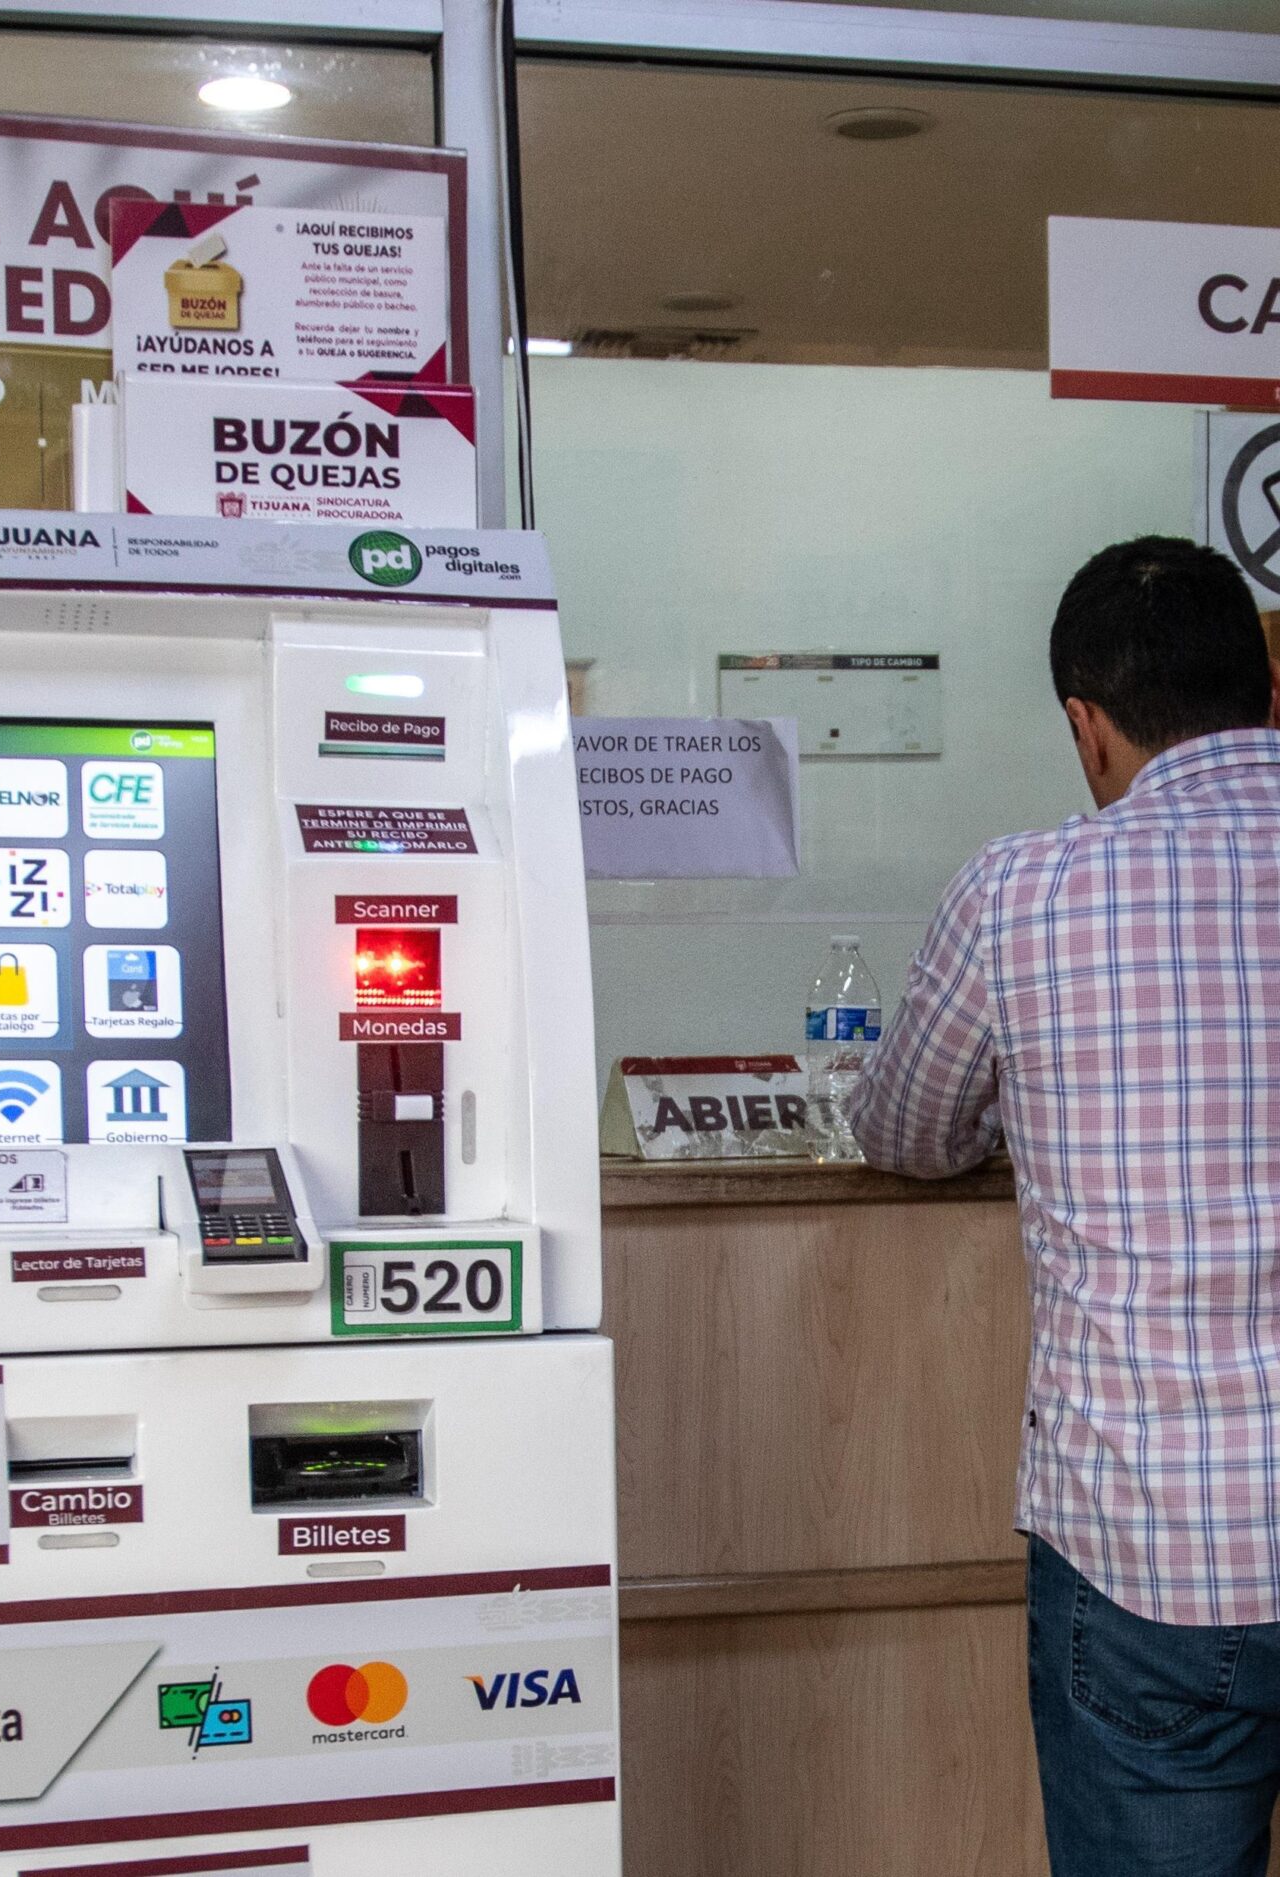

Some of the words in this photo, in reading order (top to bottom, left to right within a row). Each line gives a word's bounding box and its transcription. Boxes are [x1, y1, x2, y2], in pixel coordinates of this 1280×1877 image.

[297, 221, 335, 237] ¡AQUÍ
[339, 225, 414, 240] RECIBIMOS
[313, 243, 339, 255] TUS
[343, 244, 402, 258] QUEJAS!
[302, 262, 321, 271] Ante
[355, 264, 365, 272] de
[381, 266, 414, 275] servicio
[384, 279, 408, 287] como
[181, 297, 226, 310] BUZÓN
[1198, 273, 1280, 334] CA
[193, 311, 225, 320] QUEJAS
[377, 326, 410, 335] nombre
[136, 332, 254, 357] ¡AYÚDANOS
[260, 340, 275, 357] A
[317, 347, 347, 357] QUEJA
[357, 349, 417, 360] SUGERENCIA.
[213, 411, 400, 458] BUZÓN
[215, 461, 260, 485] DE
[271, 462, 401, 491] QUEJAS
[251, 501, 311, 511] TIJUANA
[317, 498, 390, 508] SINDICATURA
[317, 509, 403, 520] PROCURADORA
[128, 538, 219, 548] RESPONSABILIDAD
[425, 543, 480, 557] pagos
[144, 547, 180, 556] TODOS
[361, 544, 413, 575] pd
[445, 558, 521, 575] digitales
[499, 573, 522, 581] .com
[851, 658, 871, 666] TIPO
[874, 658, 885, 666] DE
[887, 658, 923, 666] CAMBIO
[330, 718, 378, 733] Recibo
[381, 722, 400, 734] de
[404, 723, 441, 737] Pago
[574, 736, 629, 751] AVOR
[634, 736, 658, 751] DE
[664, 736, 722, 752] TRAER
[729, 736, 762, 752] LOS
[577, 768, 645, 784] ECIBOS
[651, 768, 674, 783] DE
[681, 768, 733, 784] PAGO
[90, 773, 153, 803] CFE
[318, 809, 373, 818] ESPERE
[378, 810, 389, 819] A
[392, 810, 424, 820] QUE
[428, 811, 445, 820] SE
[640, 799, 719, 815] GRACIAS
[302, 819, 370, 829] TERMINE
[373, 820, 394, 829] DE
[398, 821, 468, 831] IMPRIMIR
[347, 830, 366, 839] SU
[371, 831, 428, 840] RECIBO
[313, 840, 363, 849] ANTES
[106, 883, 165, 898] Totalplay
[354, 901, 439, 918] Scanner
[21, 1013, 40, 1022] por
[92, 1017, 135, 1027] Tarjetas
[138, 1017, 175, 1027] Regalo
[353, 1018, 448, 1036] Monedas
[654, 1094, 808, 1132] ABIER
[106, 1132, 168, 1144] Gobierno
[14, 1258, 59, 1271] Lector
[63, 1257, 82, 1270] de
[87, 1256, 143, 1271] Tarjetas
[346, 1274, 354, 1306] CAJERO
[380, 1259, 503, 1314] 520
[21, 1488, 132, 1513] Cambio
[48, 1512, 106, 1526] Billetes
[292, 1526, 391, 1549] Billetes
[463, 1668, 582, 1711] VISA
[312, 1725, 406, 1745] mastercard
